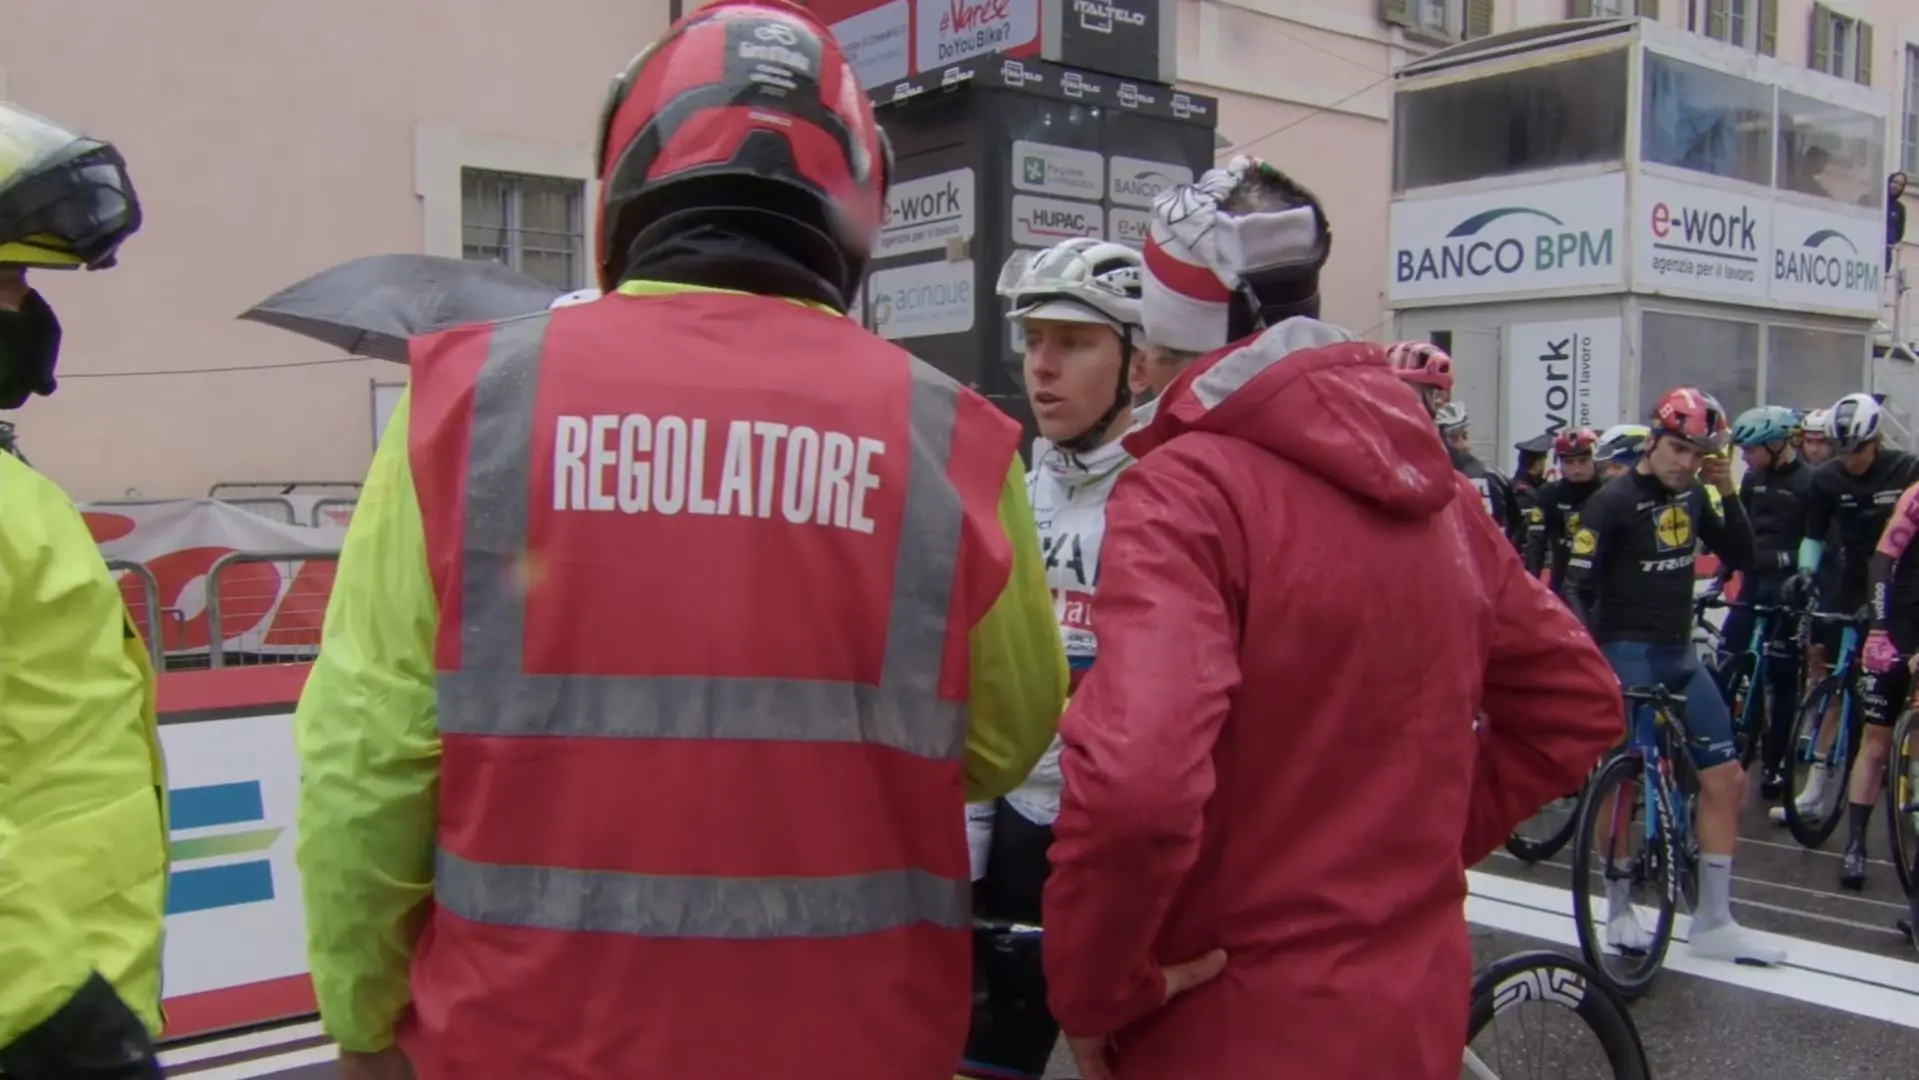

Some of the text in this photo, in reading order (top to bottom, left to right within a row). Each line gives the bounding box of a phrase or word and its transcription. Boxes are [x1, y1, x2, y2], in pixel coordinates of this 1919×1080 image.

[1033, 209, 1085, 231] HUPAC
[1652, 202, 1756, 250] e-work
[1397, 228, 1613, 282] BANCO BPM
[1652, 255, 1755, 282] agenzia per il lavoro
[1775, 248, 1879, 292] BANCO BPM
[1580, 336, 1591, 383] lavoro
[1580, 403, 1591, 426] per
[553, 413, 886, 534] REGOLATORE
